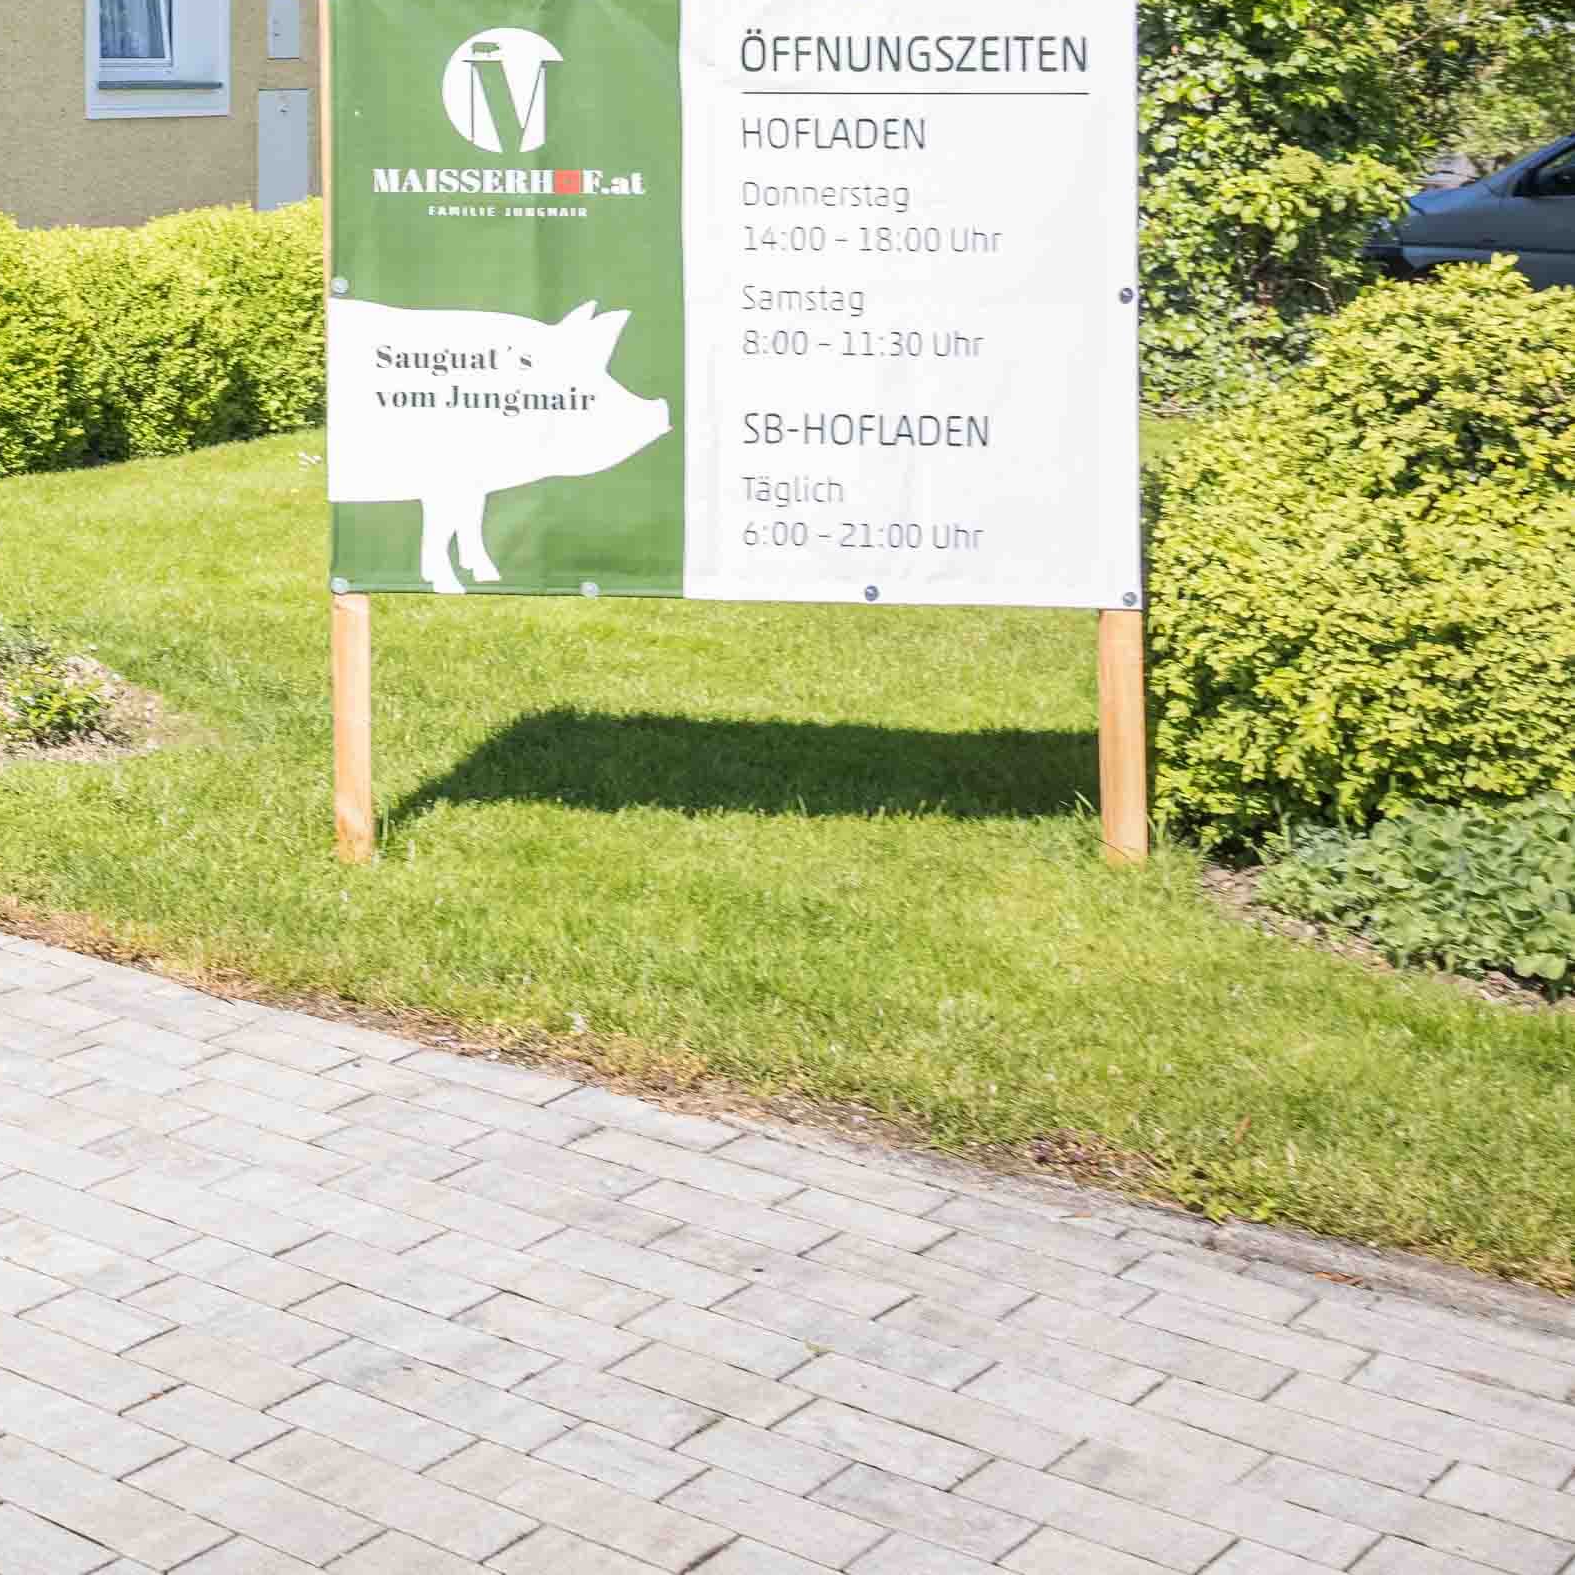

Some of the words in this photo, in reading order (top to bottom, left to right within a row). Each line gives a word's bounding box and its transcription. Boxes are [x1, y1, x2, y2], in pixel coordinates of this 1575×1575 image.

[741, 28, 1088, 73] ÖFFNUNGSZEITEN
[741, 117, 926, 150] HOFLADEN
[427, 205, 496, 217] FAMILIE
[742, 181, 911, 213] Donnerstag
[743, 225, 826, 252] 14:00
[858, 226, 941, 252] 18:00
[950, 226, 1003, 253] Uhr
[740, 285, 865, 317] Samstag
[742, 329, 809, 355] 8:00
[841, 330, 923, 356] 11:30
[932, 331, 985, 357] Uhr
[375, 391, 436, 408] vom
[444, 385, 596, 417] Jungmair
[742, 412, 990, 448] SB-HOFLADEN
[740, 475, 845, 508] Täglich
[742, 521, 809, 547] 6:00
[838, 522, 923, 549] 21:00
[932, 523, 985, 550] Uhr
